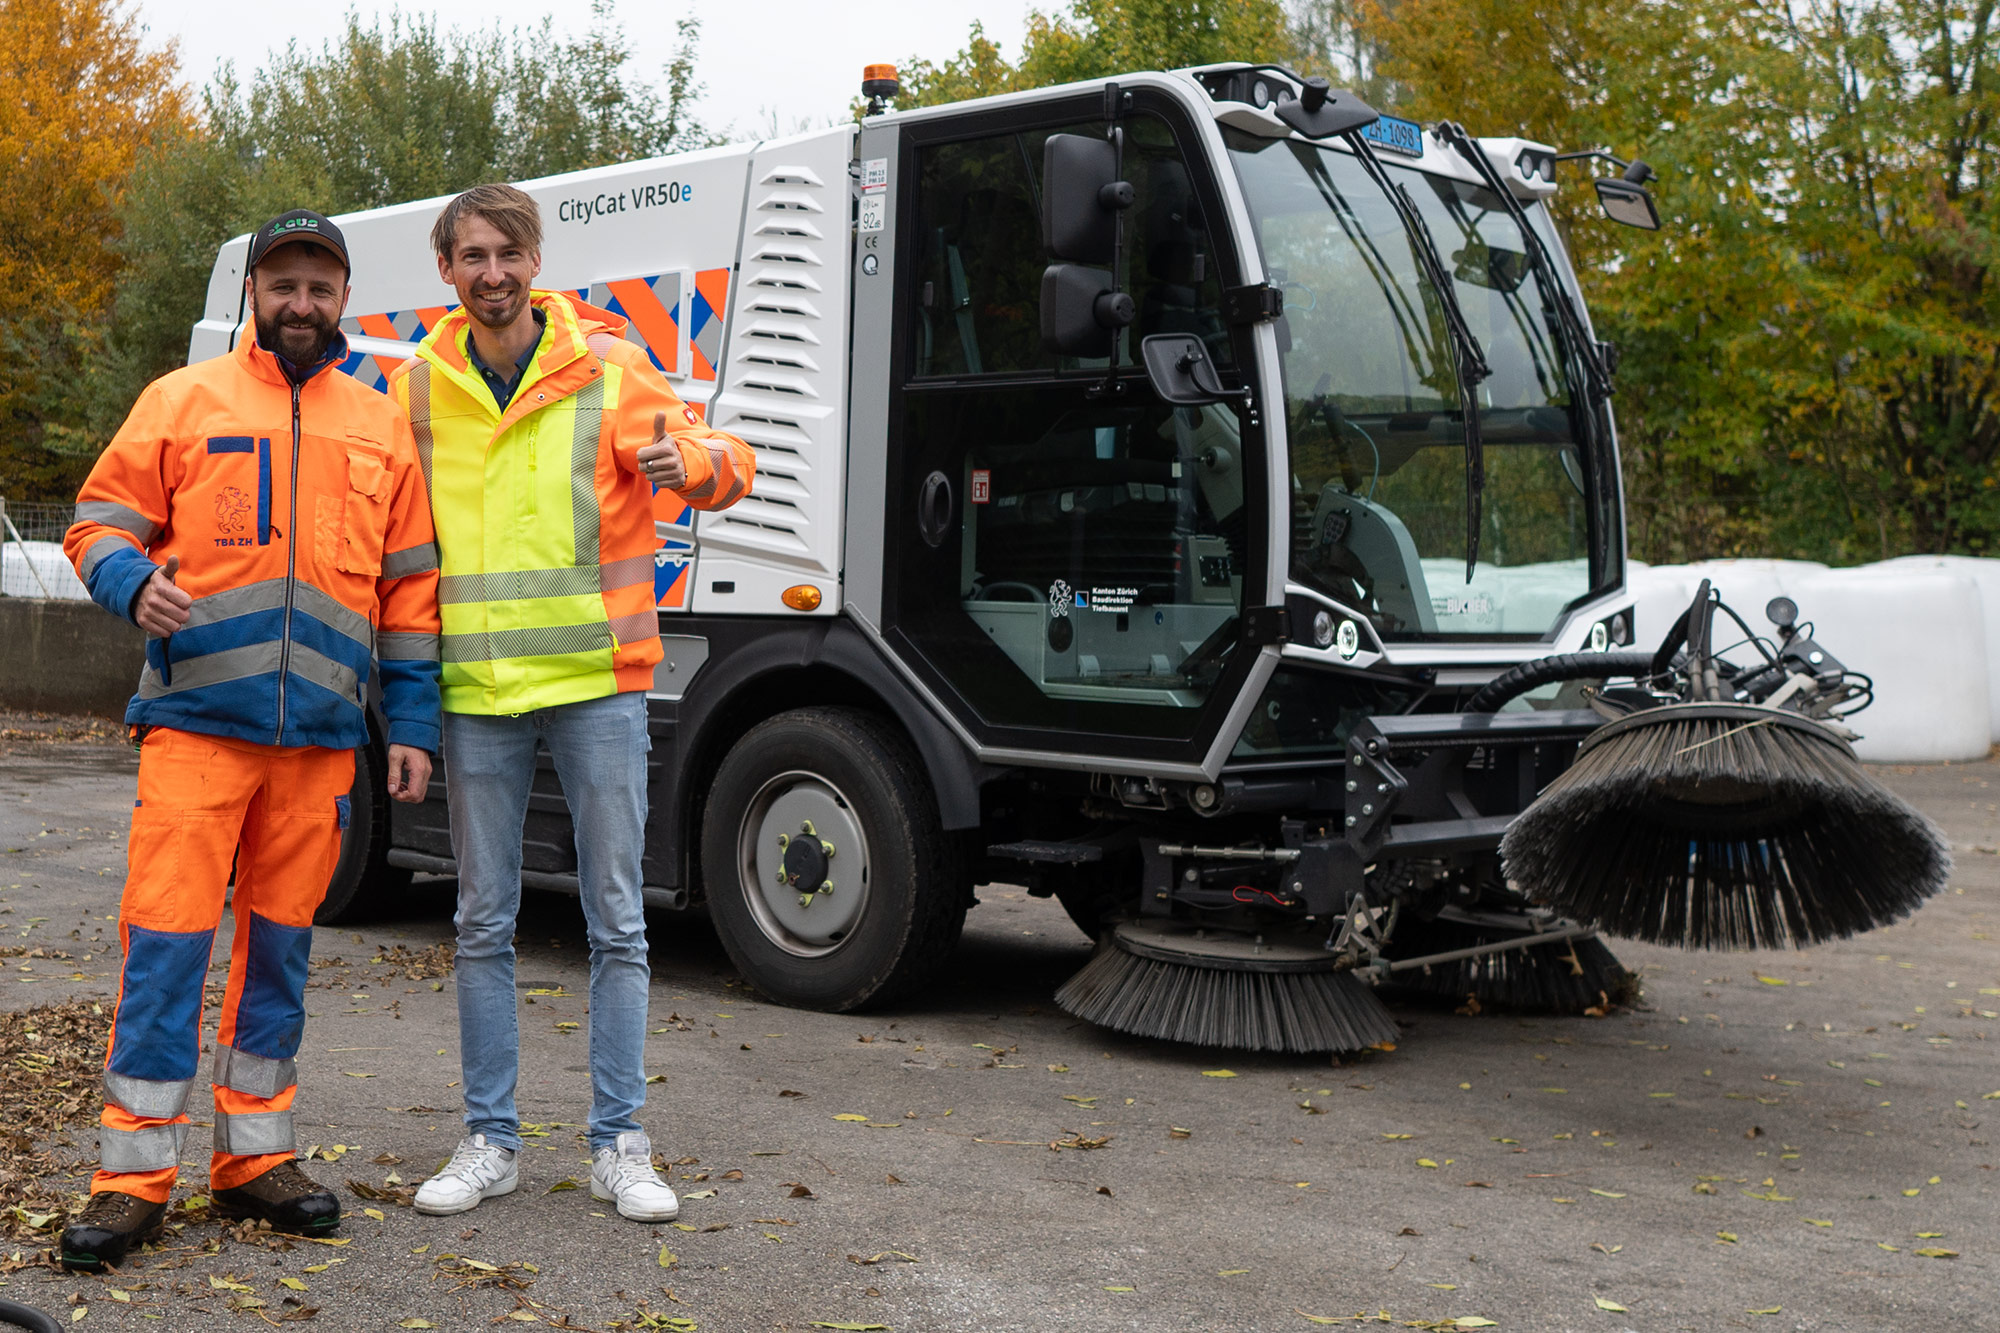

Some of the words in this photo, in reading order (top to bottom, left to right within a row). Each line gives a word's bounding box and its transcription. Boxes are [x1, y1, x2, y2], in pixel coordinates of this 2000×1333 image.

[559, 192, 626, 224] CityCat
[631, 181, 692, 209] VR50e
[214, 538, 235, 547] TBA
[237, 538, 253, 546] ZH
[1092, 587, 1116, 595] Kanton
[1117, 587, 1138, 595] Zürich
[1092, 596, 1133, 604] Baudirektion
[1092, 605, 1129, 613] Tiefbauamt
